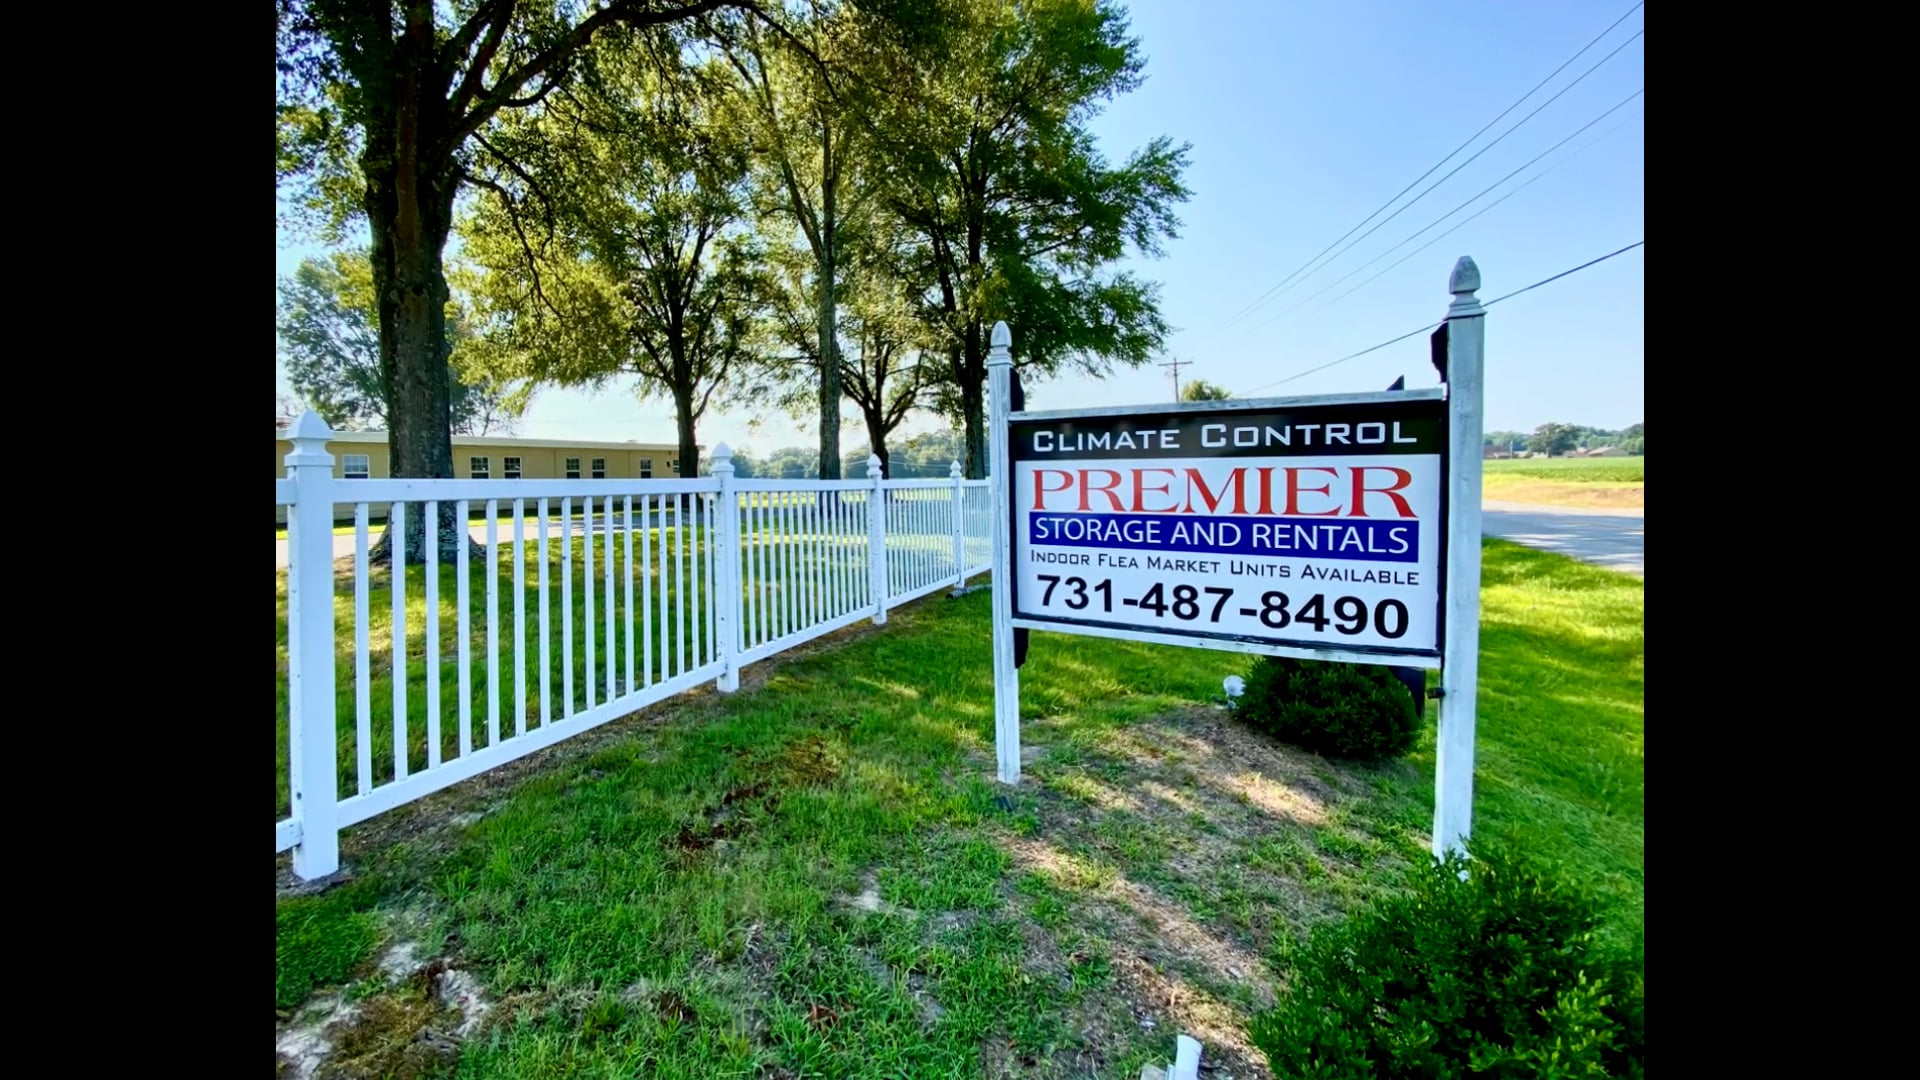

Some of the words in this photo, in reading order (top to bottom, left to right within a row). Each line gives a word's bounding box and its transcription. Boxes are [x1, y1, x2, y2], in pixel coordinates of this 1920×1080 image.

[1033, 428, 1181, 453] CLIMATE
[1201, 421, 1417, 448] CONTROL
[1031, 466, 1417, 518] PREMIER
[1035, 517, 1162, 544] STORAGE
[1170, 521, 1242, 547] AND
[1252, 524, 1409, 554] RENTALS
[1031, 549, 1090, 566] INDOOR
[1097, 552, 1139, 569] FLEA
[1147, 555, 1221, 574] MARKET
[1230, 560, 1291, 579] UNITS
[1300, 564, 1420, 586] AVAILABLE
[1036, 574, 1410, 639] 731-487-8490
